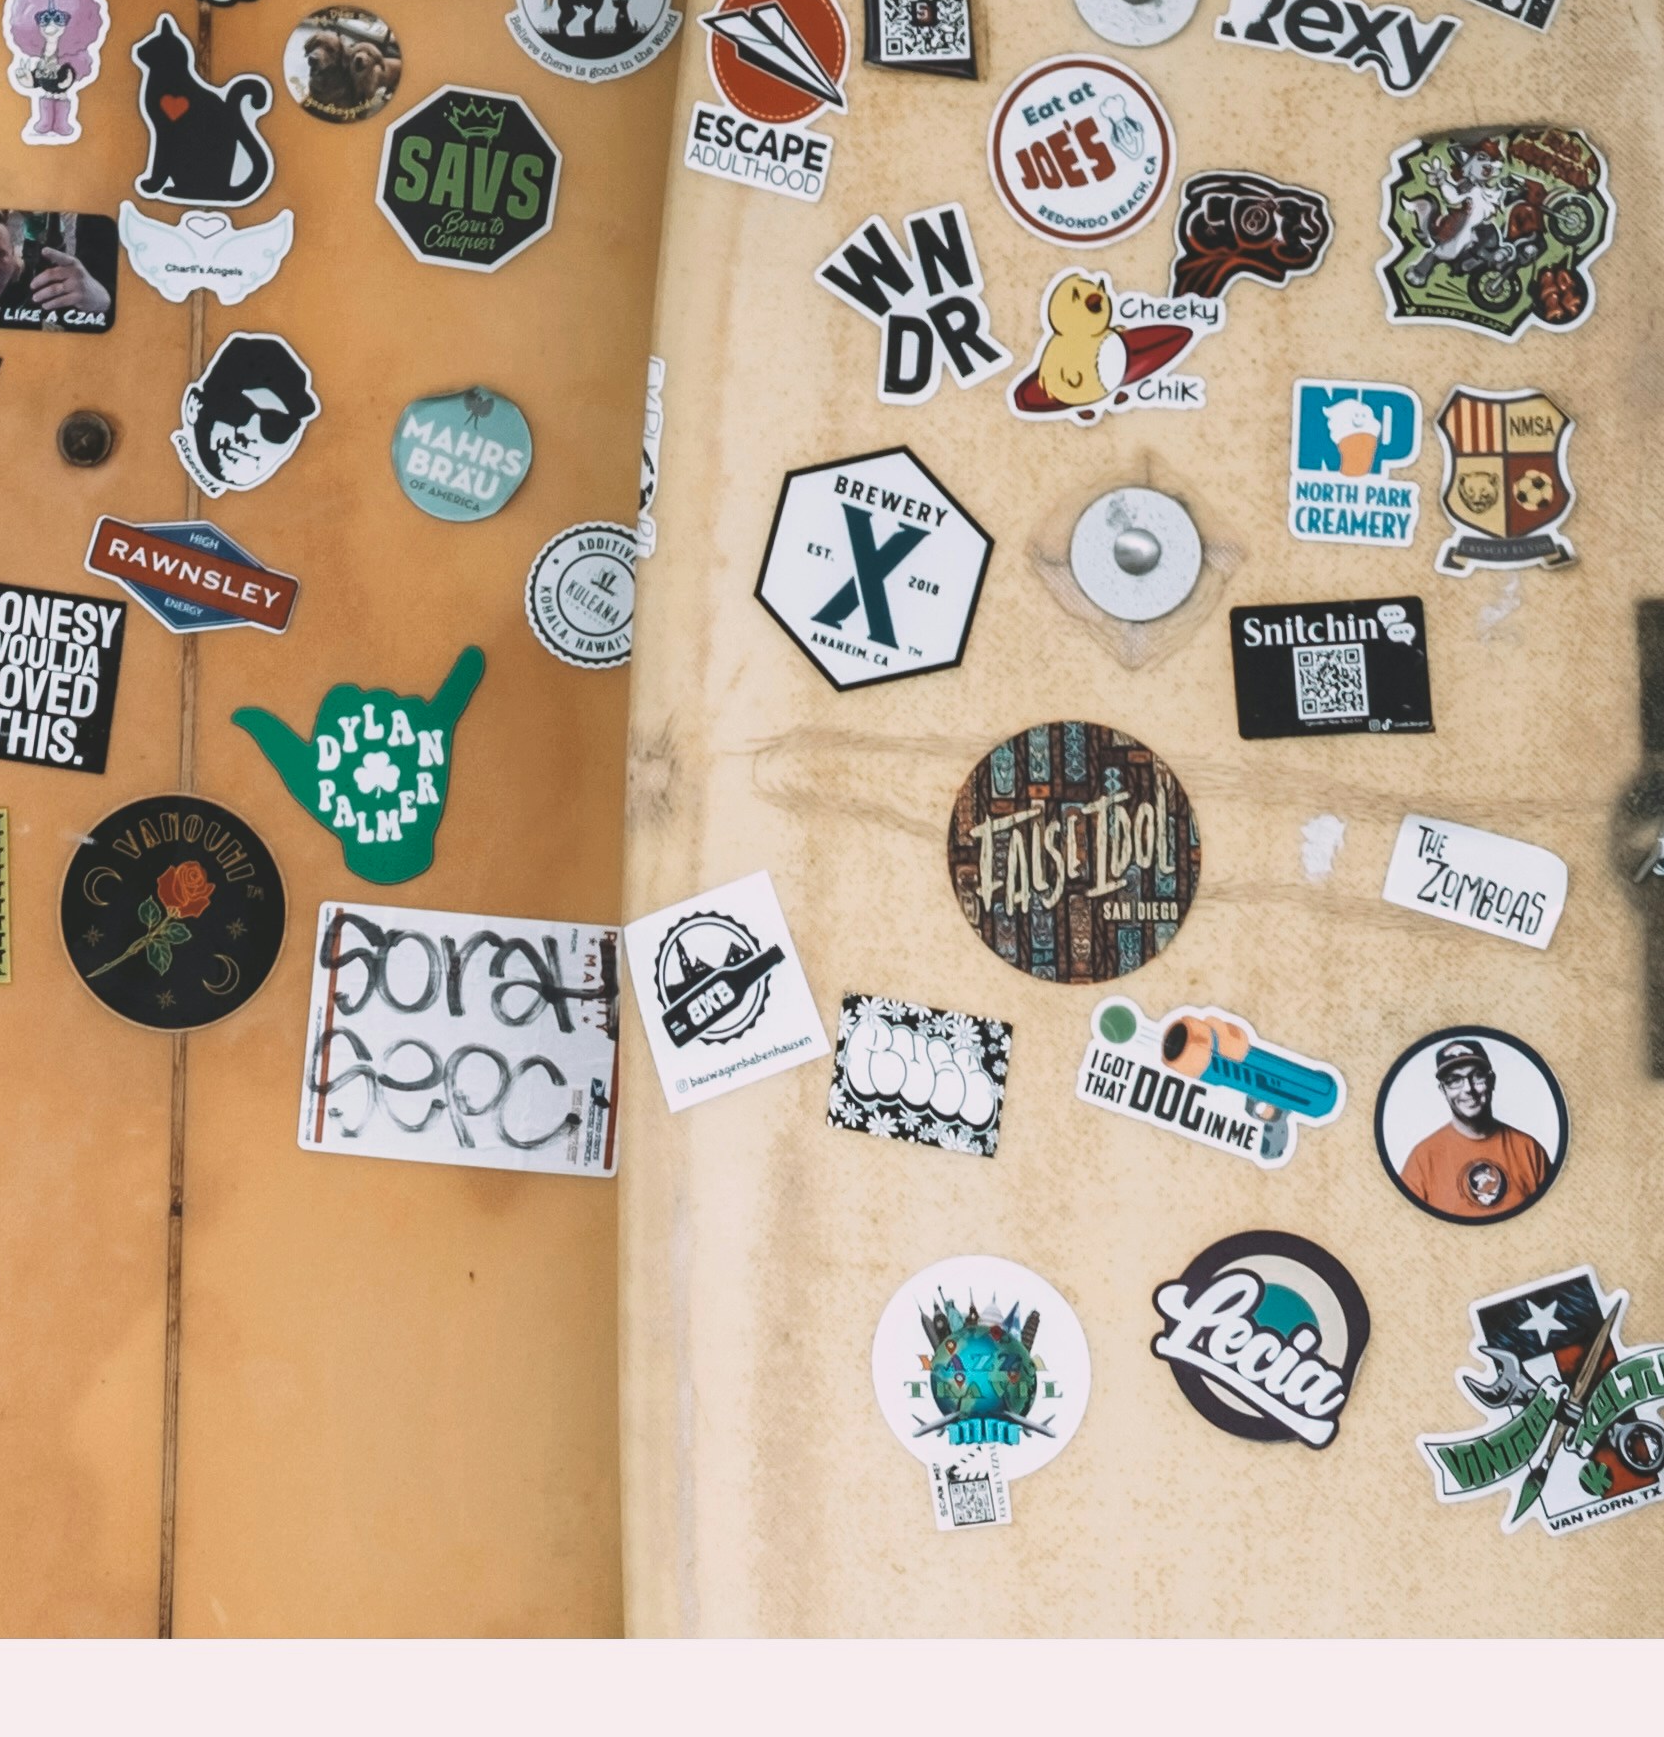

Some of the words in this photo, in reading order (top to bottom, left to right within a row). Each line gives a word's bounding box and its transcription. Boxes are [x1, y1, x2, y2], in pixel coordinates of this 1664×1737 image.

[512, 15, 550, 60] Believe
[544, 50, 573, 75] there
[575, 64, 586, 78] is
[588, 61, 619, 80] good
[620, 57, 634, 71] in
[633, 46, 654, 66] the
[651, 13, 679, 50] World
[1023, 95, 1062, 127] Eat
[1064, 81, 1096, 106] at
[694, 111, 827, 172] ESCAPE
[1014, 117, 1117, 192] JOE'S
[689, 141, 822, 196] ADULTHOOD
[1038, 205, 1108, 229] REDONDO
[1110, 178, 1155, 226] BEACH,
[1143, 156, 1157, 175] CA
[1119, 298, 1219, 325] Cheeky
[402, 420, 525, 477] MAHRS
[1509, 415, 1555, 438] NMSA
[406, 447, 500, 502] BRÄU
[409, 479, 430, 495] OF
[426, 486, 481, 513] AMERICA
[834, 475, 948, 527] BREWERY
[1296, 482, 1359, 506] NORTH
[1365, 486, 1412, 508] PARK
[1296, 507, 1411, 539] CREAMERY
[108, 538, 282, 610] RAWNSLEY
[807, 542, 834, 561] EST.
[811, 502, 931, 649] X
[908, 576, 940, 596] 2018
[811, 632, 868, 661] ANAHEIM,
[874, 653, 888, 667] CA
[1244, 617, 1379, 647] Snitchin
[317, 704, 444, 771] DYLAN
[318, 773, 438, 843] PALMER
[1418, 826, 1448, 858] THE
[1103, 902, 1132, 920] SAN
[1137, 901, 1178, 920] DIEGO
[1417, 858, 1546, 935] ZOMBOAS
[1092, 1049, 1100, 1070] I
[1101, 1054, 1134, 1080] GOT
[1084, 1073, 1127, 1106] THAT
[1131, 1065, 1207, 1131] DOG
[1204, 1116, 1224, 1142] IN
[1225, 1122, 1258, 1151] ME
[1156, 1273, 1345, 1423] Lecia
